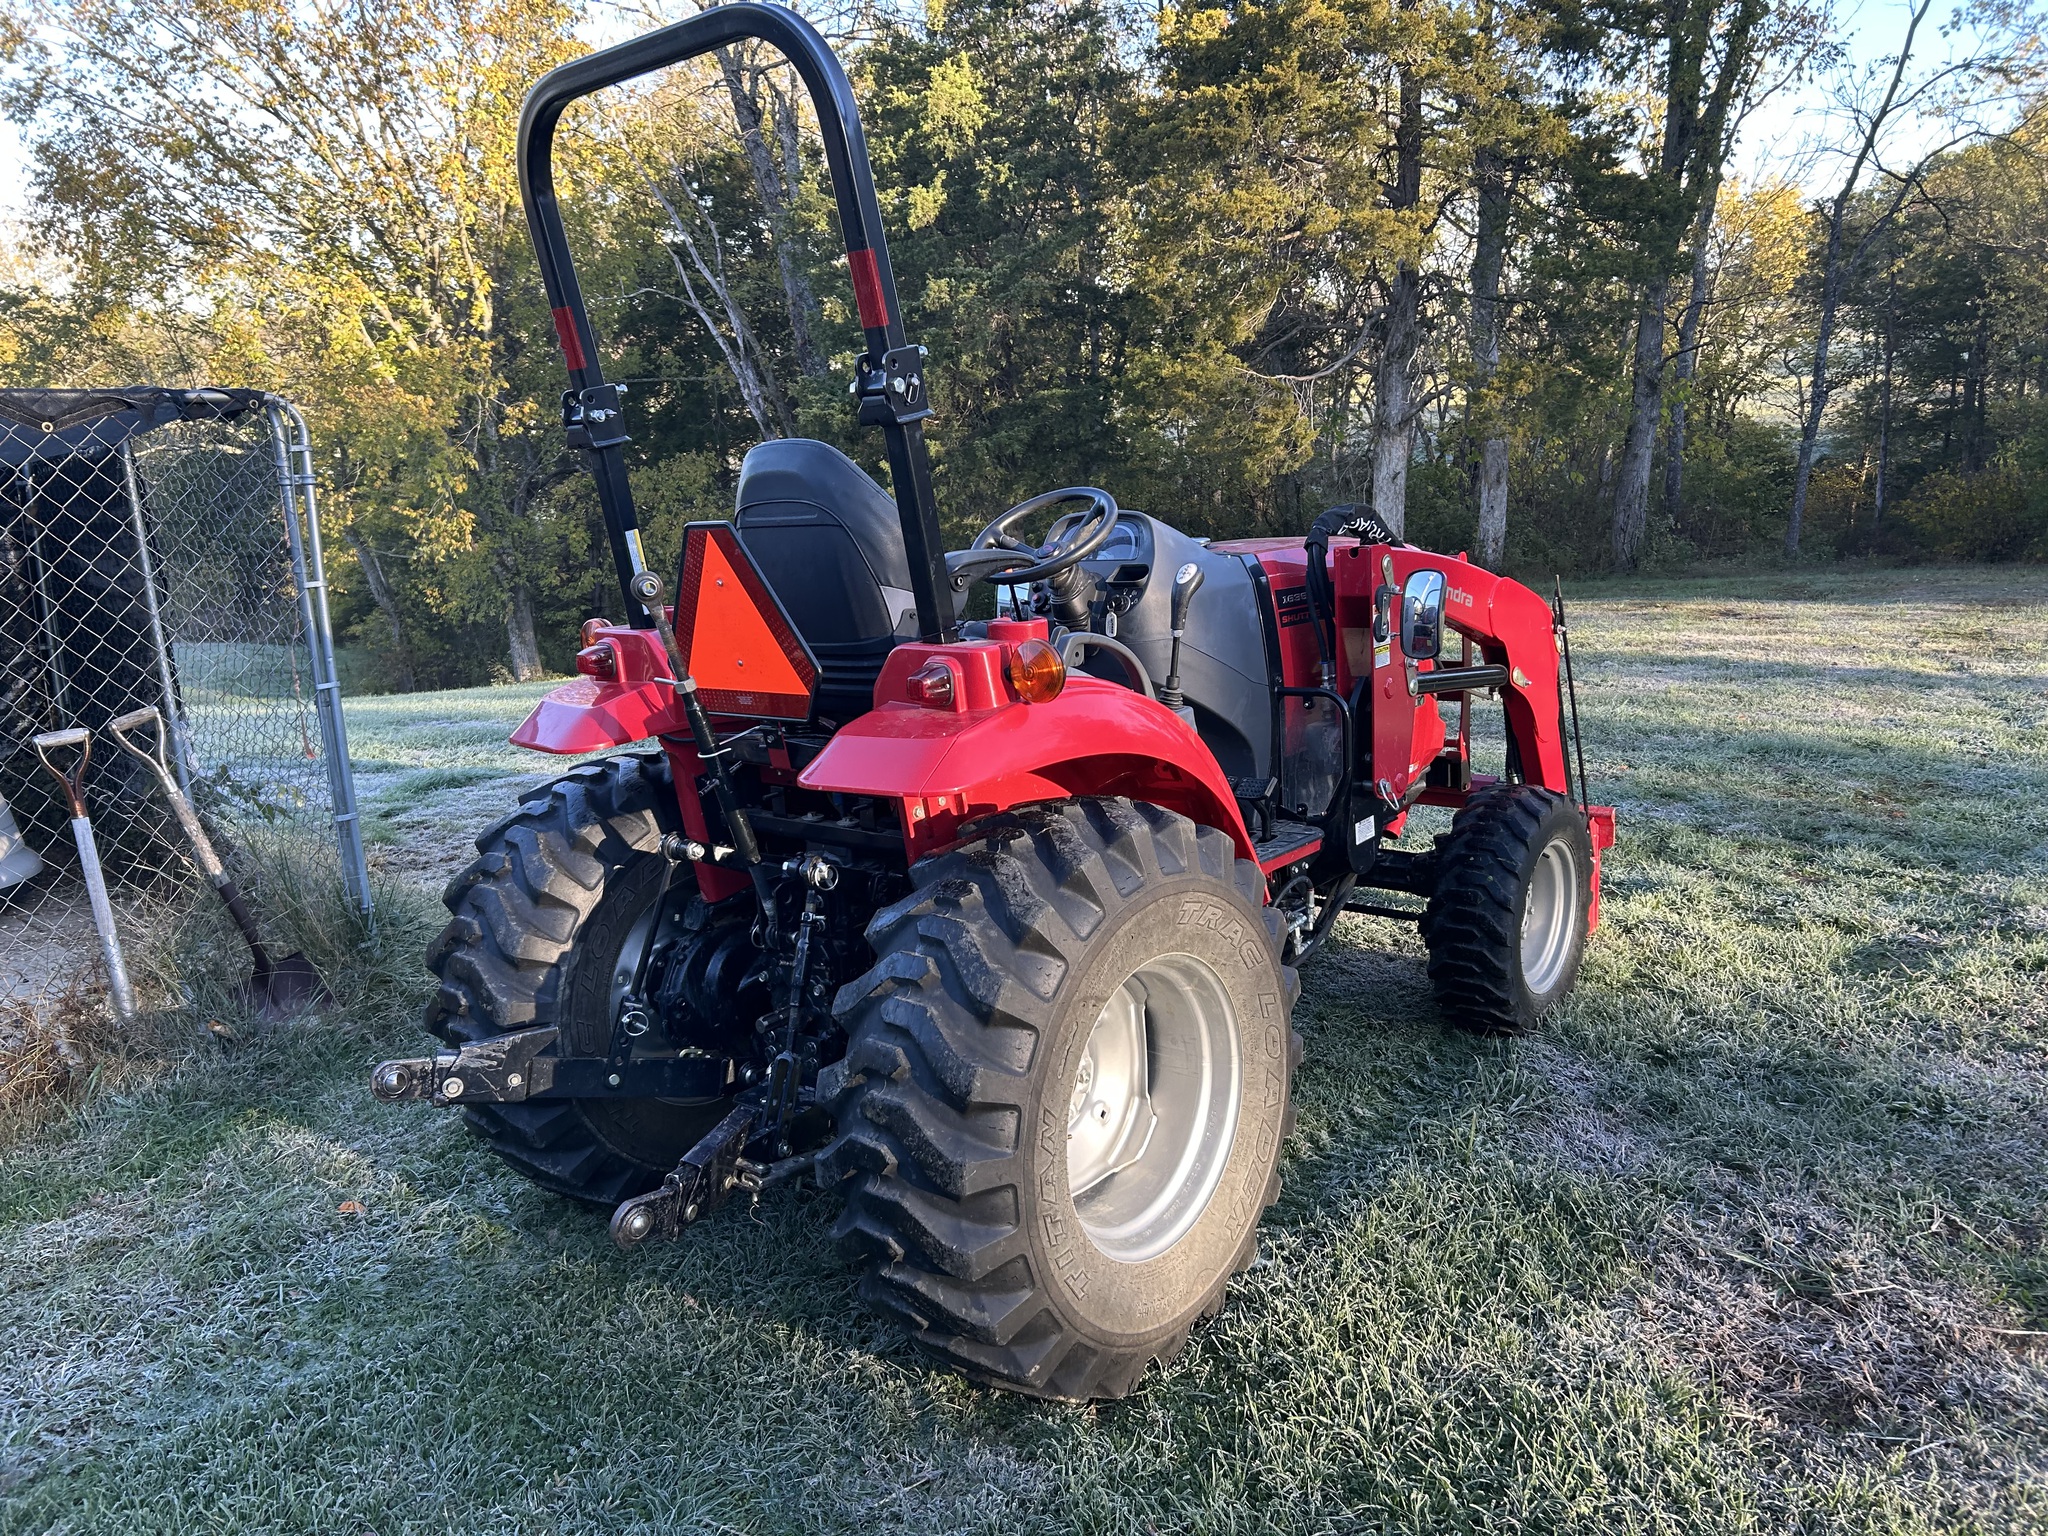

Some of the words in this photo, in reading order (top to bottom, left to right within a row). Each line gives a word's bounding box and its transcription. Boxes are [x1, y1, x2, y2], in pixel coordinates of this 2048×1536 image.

[1446, 585, 1474, 608] ndra
[1177, 900, 1264, 970] TRAC
[1224, 993, 1281, 1241] LOADER
[1040, 1106, 1091, 1301] TITAN
